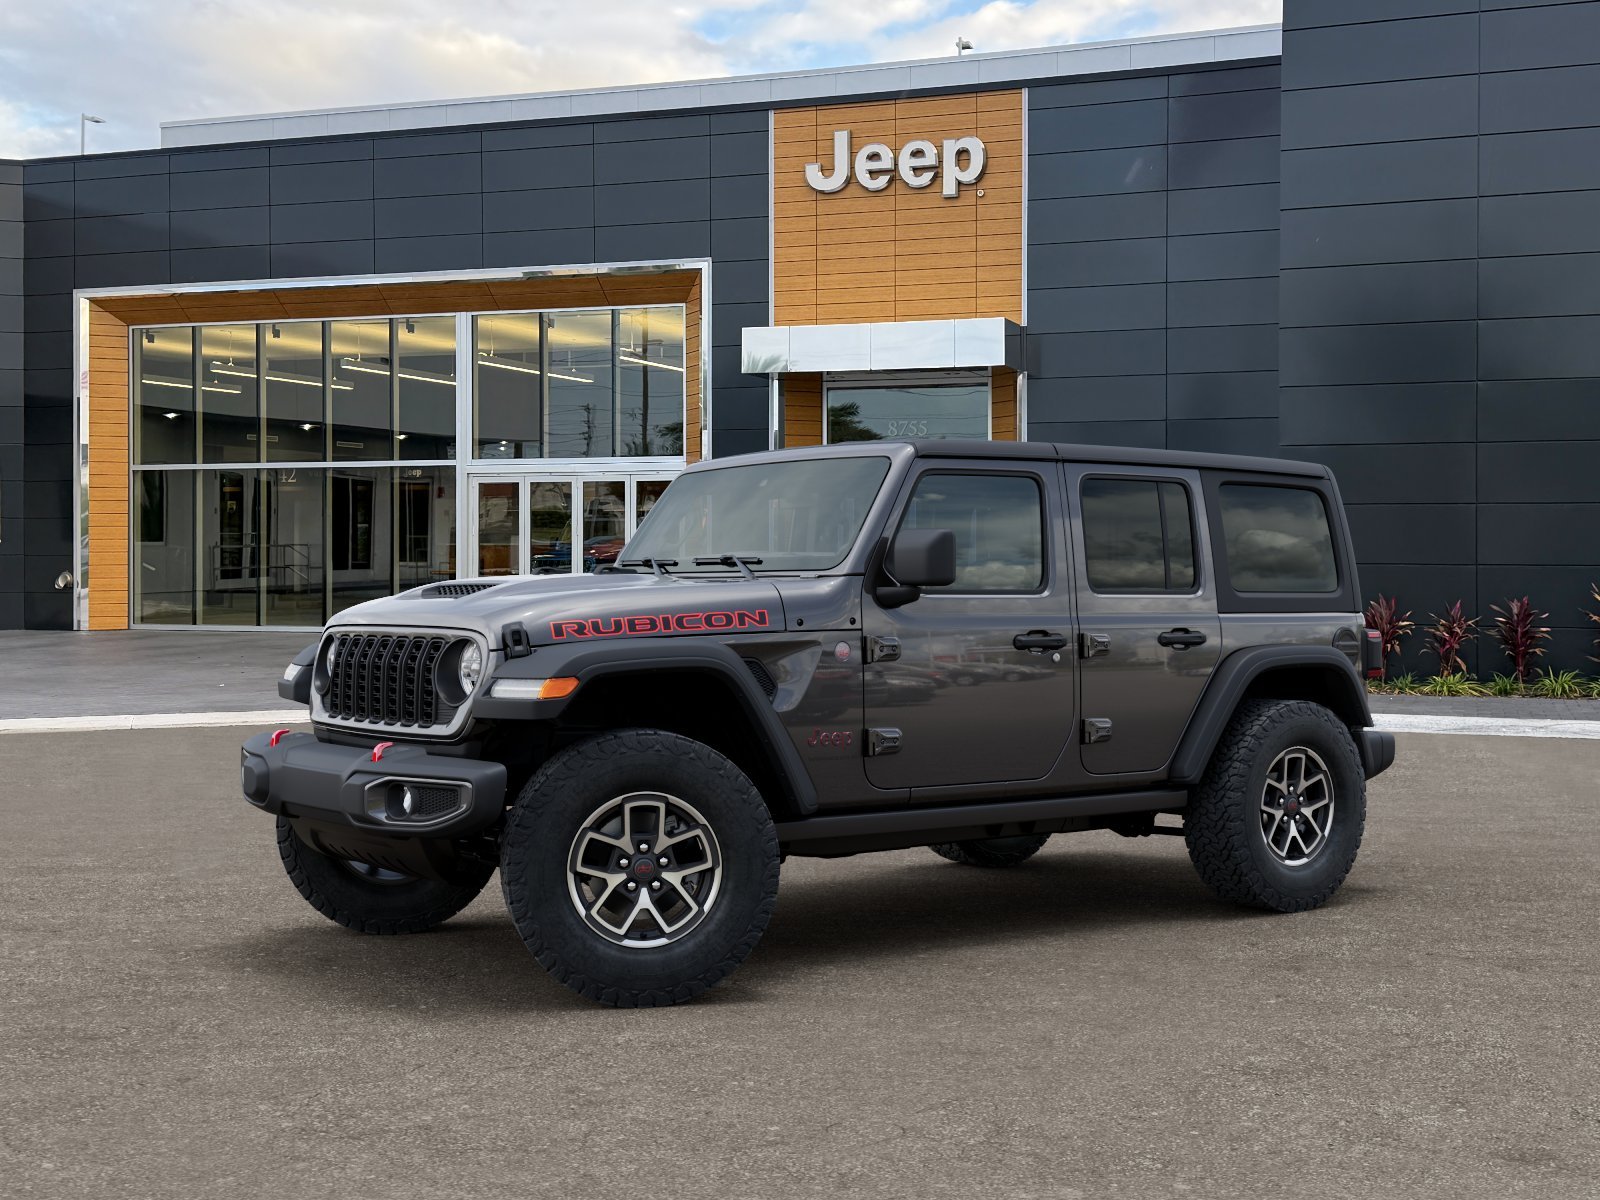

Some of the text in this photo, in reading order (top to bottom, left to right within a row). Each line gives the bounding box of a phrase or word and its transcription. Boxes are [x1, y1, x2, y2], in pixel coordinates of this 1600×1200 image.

[805, 130, 987, 198] Jeep
[888, 421, 928, 437] 8755
[550, 609, 768, 639] RUBICON
[808, 727, 852, 752] Jeep
